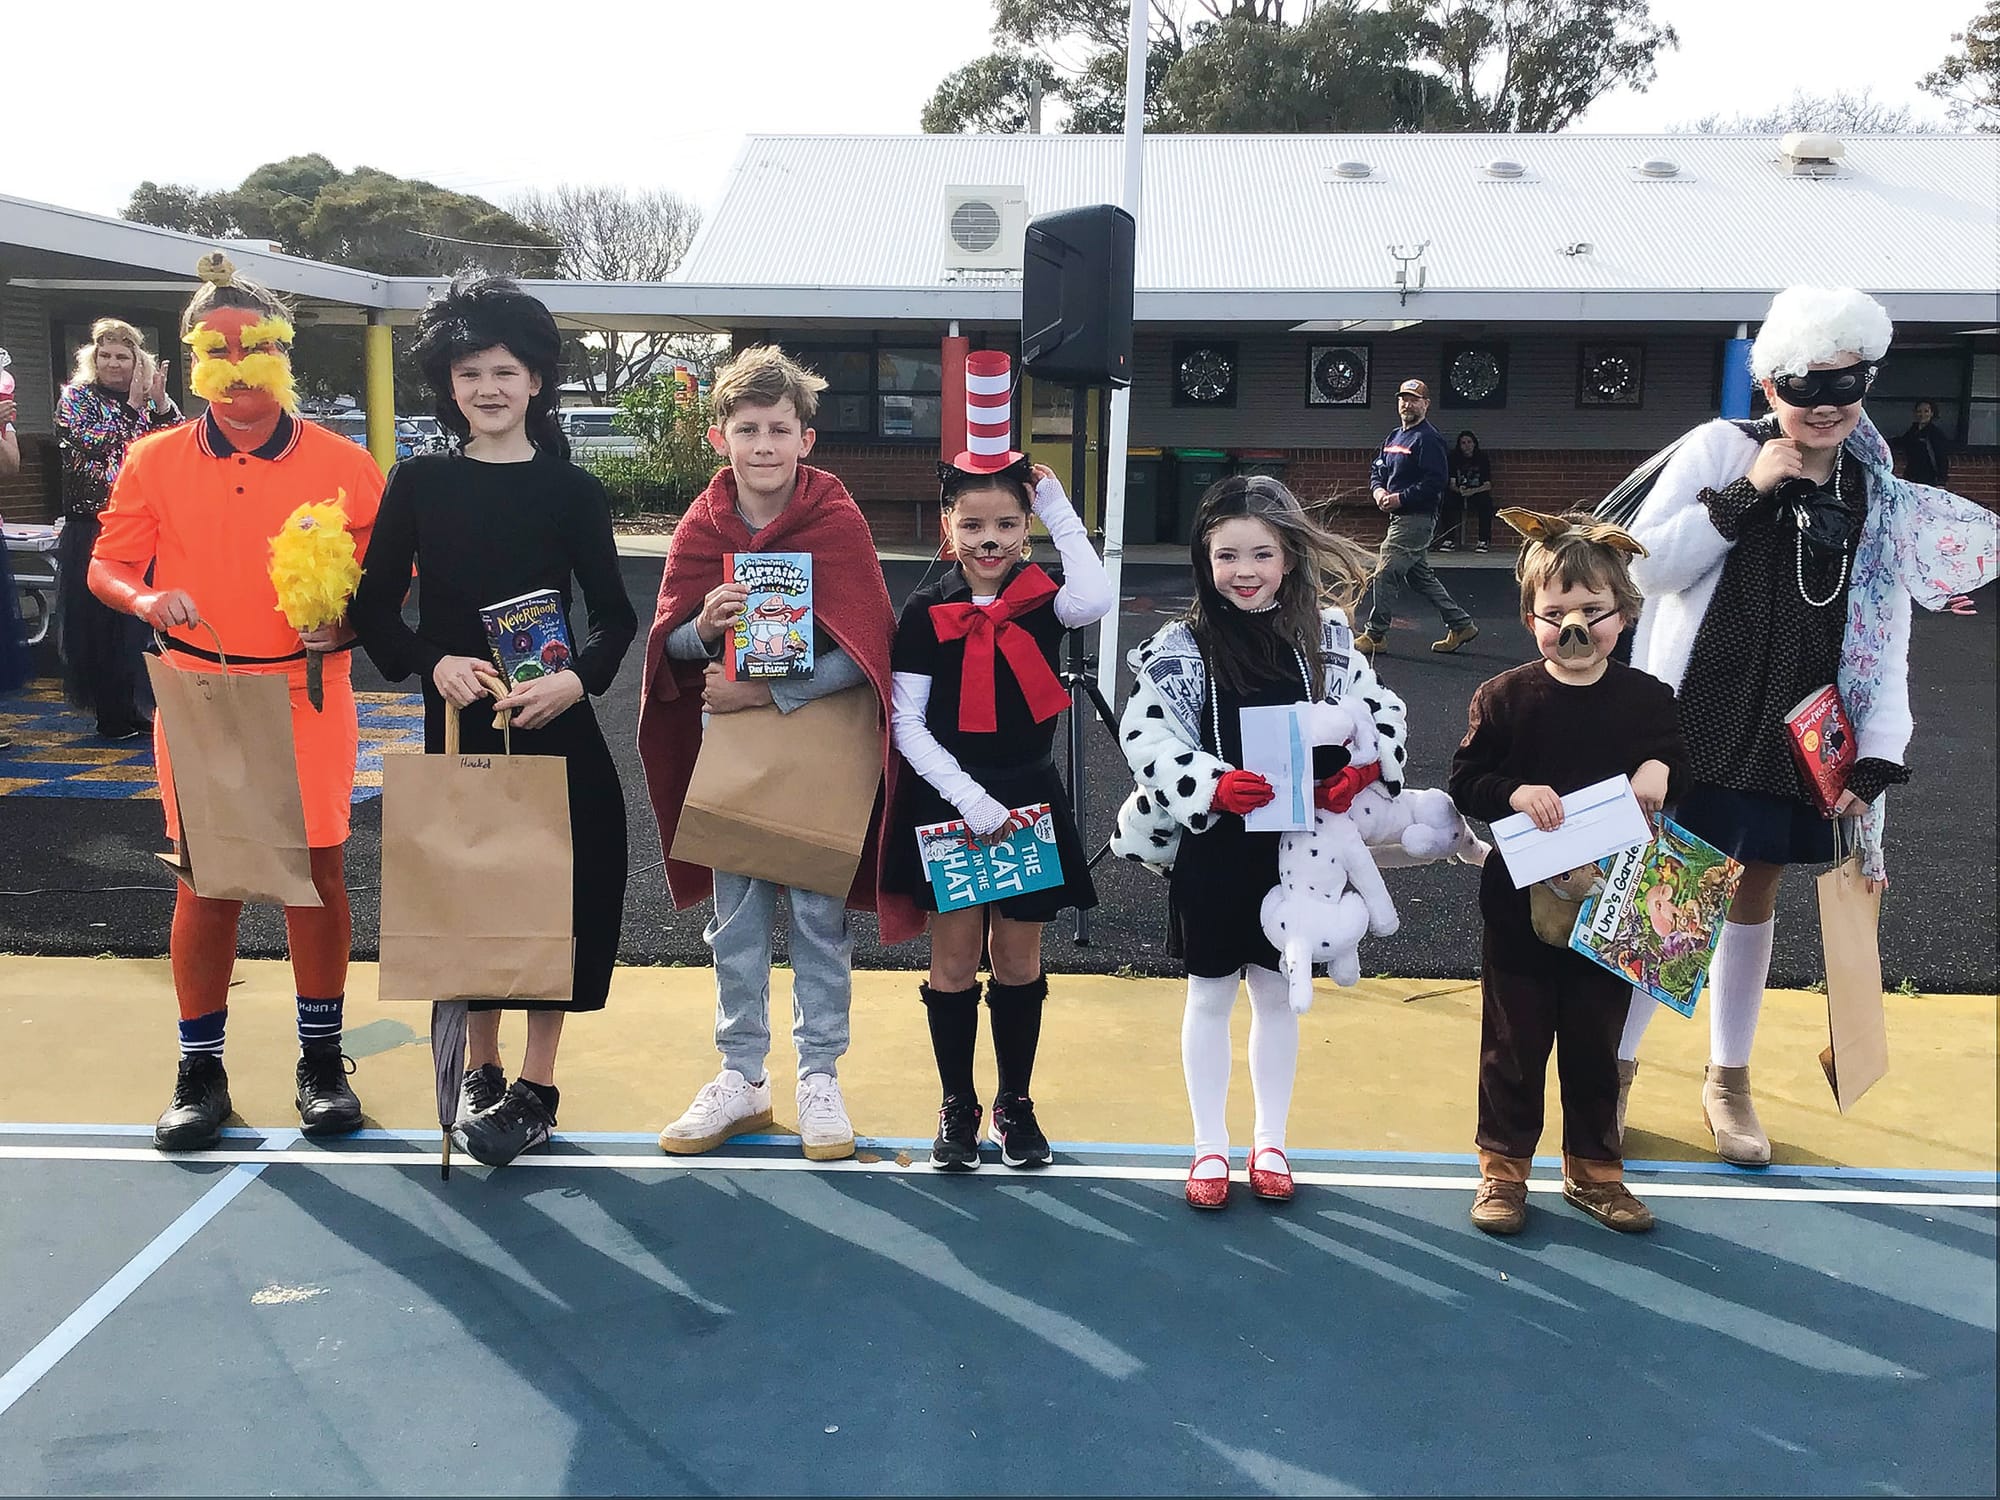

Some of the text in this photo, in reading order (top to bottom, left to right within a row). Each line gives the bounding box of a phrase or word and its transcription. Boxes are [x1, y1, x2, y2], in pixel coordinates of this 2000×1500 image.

[734, 565, 803, 581] CAPTAIN
[736, 575, 808, 592] NDERPANTS
[943, 852, 977, 902] HAT
[971, 853, 990, 891] IN THE
[989, 841, 1024, 892] CAT
[1021, 841, 1043, 877] THE
[1598, 898, 1621, 934] Uno's
[1614, 844, 1642, 891] Garde
